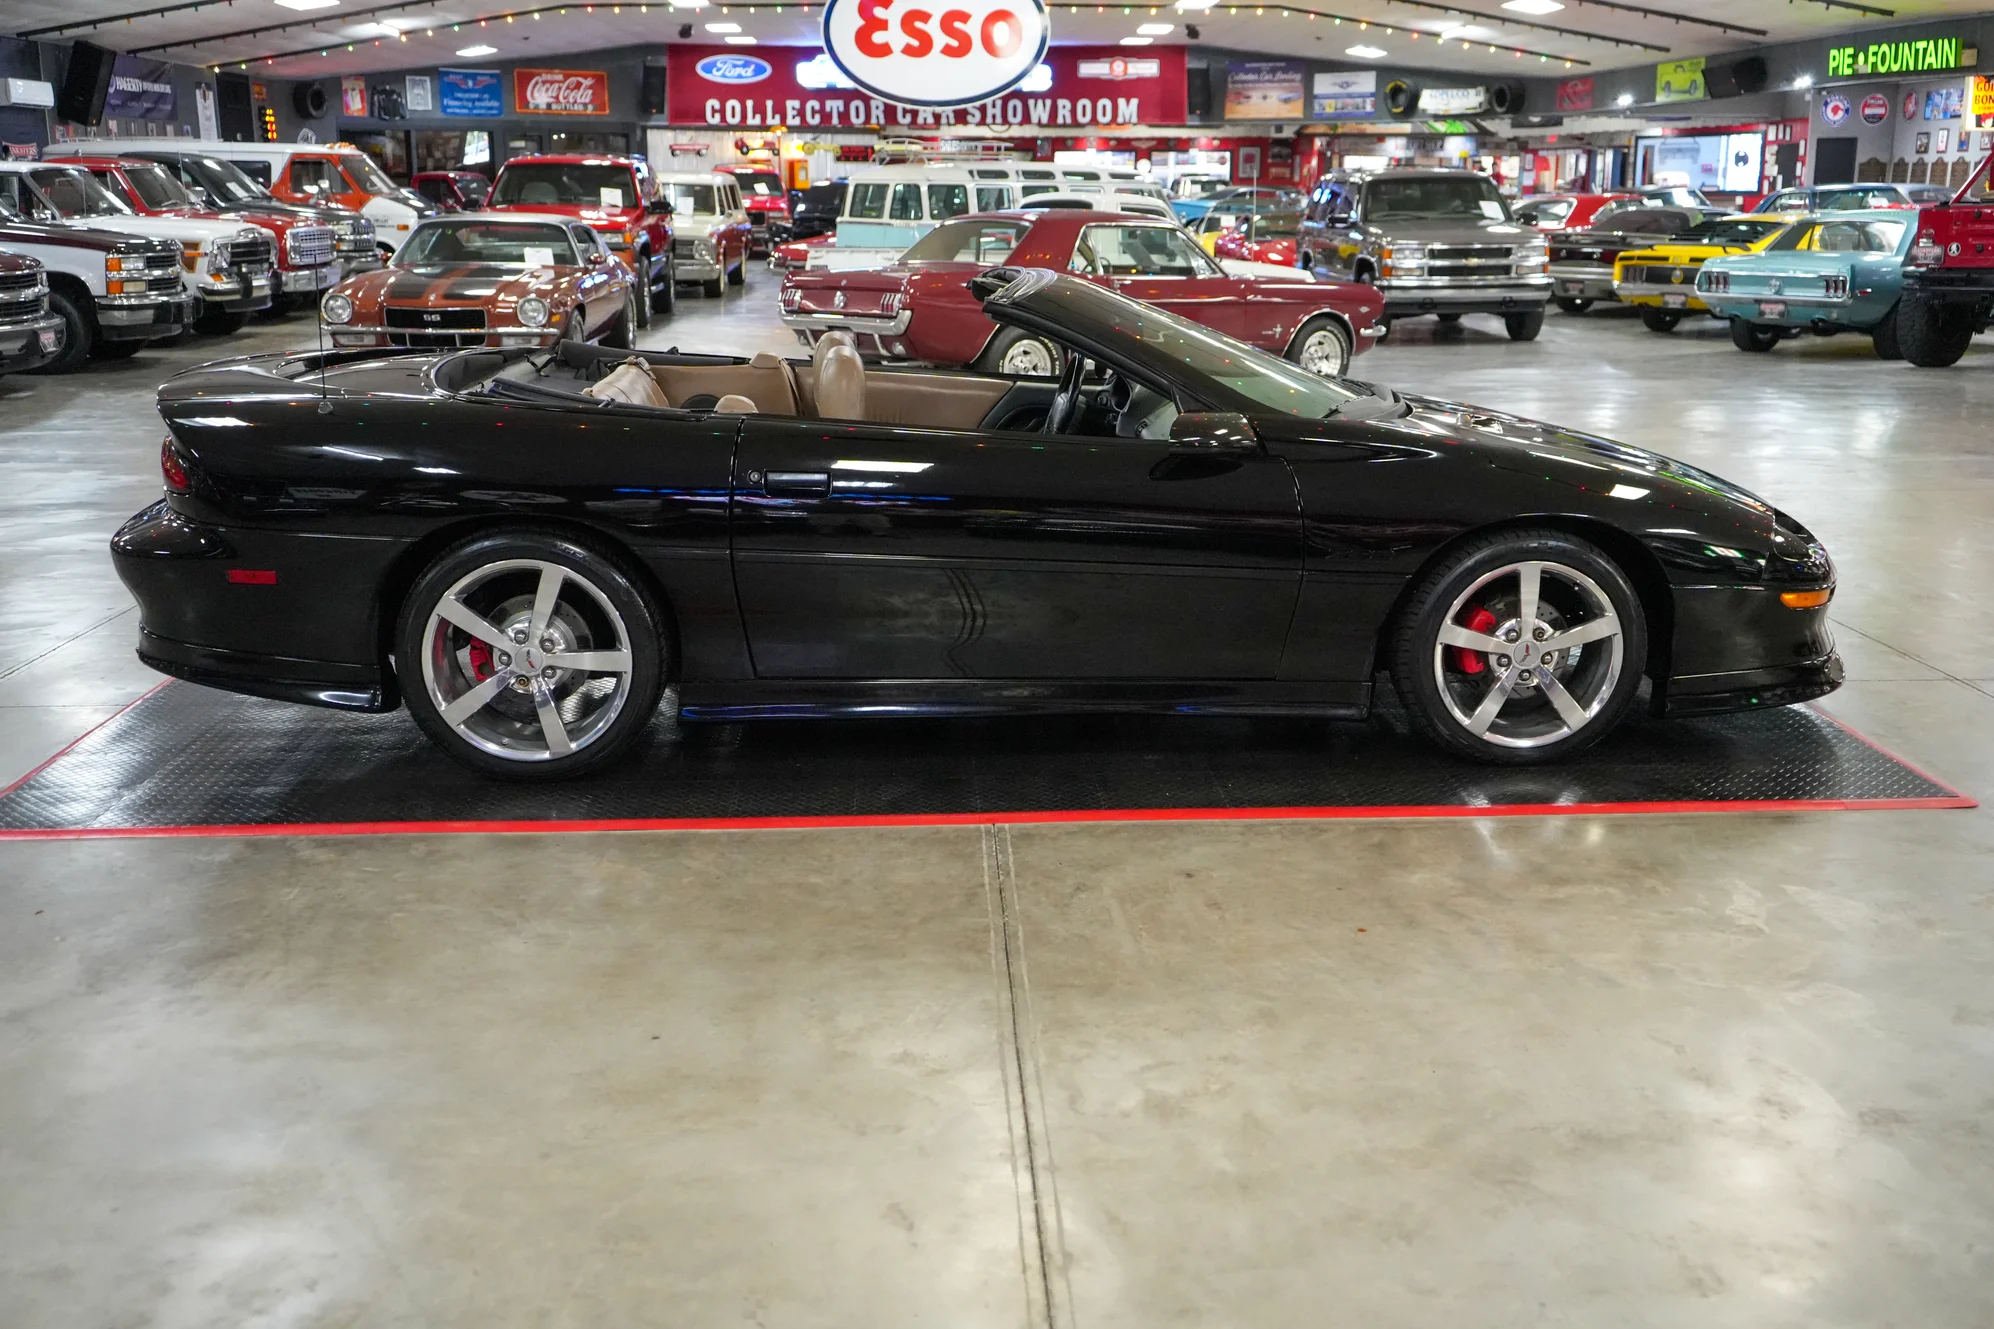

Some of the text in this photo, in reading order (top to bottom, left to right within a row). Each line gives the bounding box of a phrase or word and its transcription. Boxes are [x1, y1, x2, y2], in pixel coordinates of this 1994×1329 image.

[712, 60, 755, 77] Ford
[1829, 38, 1956, 76] PIE FOUNTAIN
[115, 76, 142, 92] HAGERTY
[526, 76, 594, 103] Coca-Cola
[705, 99, 886, 125] COLLECTOR
[965, 98, 1139, 125] SHOWROOM
